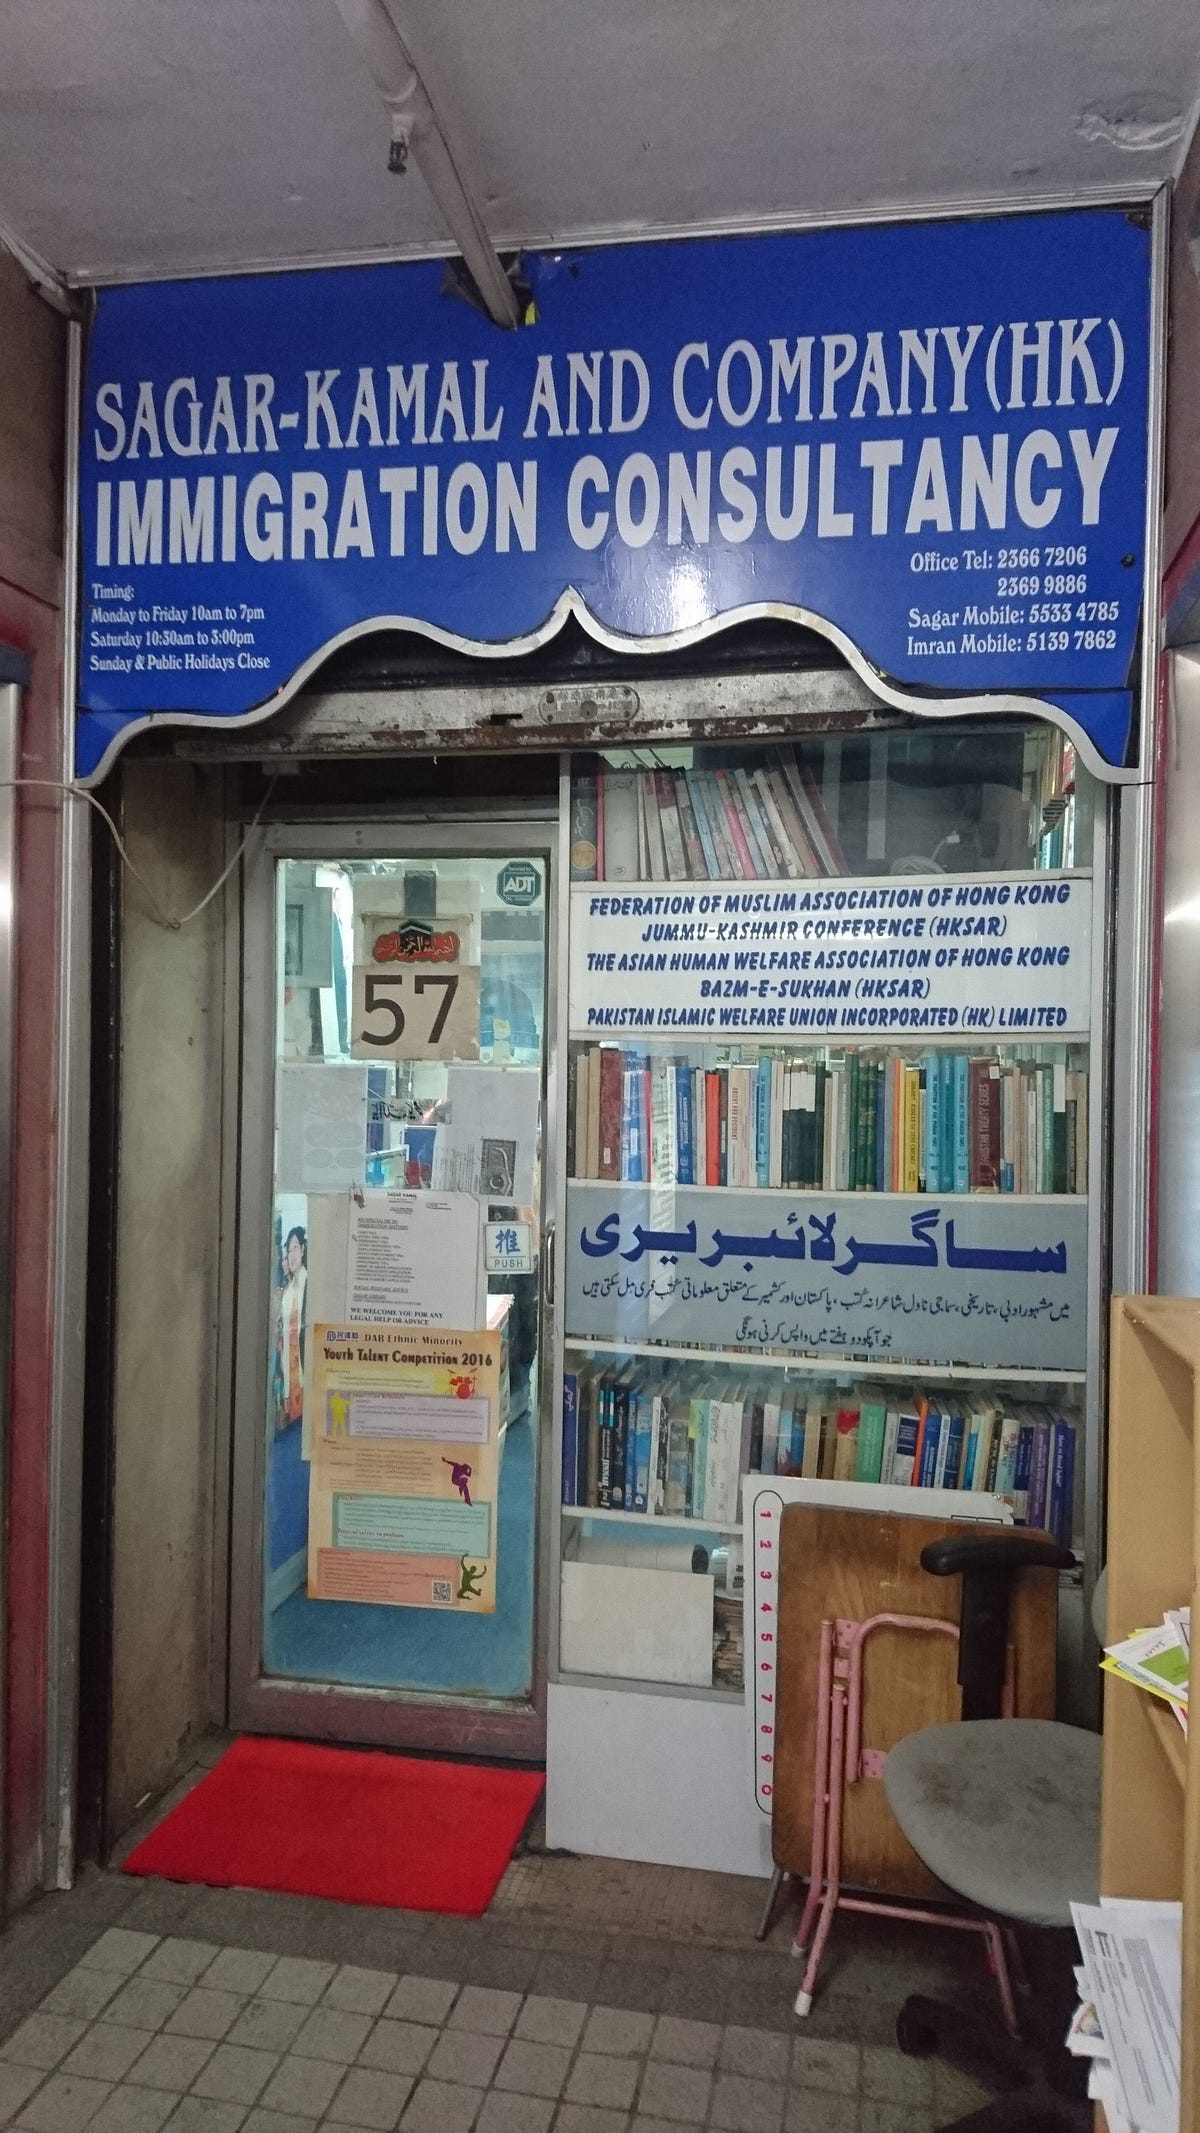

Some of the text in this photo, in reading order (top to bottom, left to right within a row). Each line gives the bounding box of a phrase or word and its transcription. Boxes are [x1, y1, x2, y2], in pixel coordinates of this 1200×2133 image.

[95, 318, 1125, 462] SAGAR-KAMAL AND COMPANY(HK)
[96, 427, 1120, 567] IMMIGRATION CONSULTANCY
[910, 546, 1087, 572] Office Tel: 2366 7206
[91, 583, 135, 601] Timing:
[997, 574, 1087, 597] 2369 9886
[91, 604, 265, 624] Monday to Friday 10am to 7pm
[908, 601, 1119, 631] Sagar Mobile: 5533 4785
[91, 631, 142, 649] Saturday
[197, 631, 209, 645] to
[907, 630, 1117, 655] Imran Mobile: 5139 7862
[90, 653, 270, 673] Sunday & Public Holidays Close
[504, 877, 534, 893] ADT
[589, 883, 1070, 916] FEDERATION OF MUSLIM ASSOCIATION OF HONG KONG
[642, 915, 1007, 942] JUMMU-KASHMIR CONFERENCE (HKSAR)
[587, 946, 1070, 971] THE ASIAN HUMAN WELFARE ASSOCIATION OF HONG KONG
[700, 977, 930, 999] BAZM-E-SUKHAN (HKSAR)
[361, 974, 459, 1046] 57
[587, 1006, 1068, 1028] PAKISTAN ISLAMIC WELFARE UNION INCORPORATED (HK) LIMITED
[495, 1229, 520, 1255] 推
[580, 1208, 1067, 1276] ساگر لائبریری
[494, 1259, 523, 1268] PUSH
[362, 1308, 396, 1316] WELCOME
[364, 1333, 384, 1342] DAB
[387, 1334, 419, 1344] Ethnic
[422, 1336, 463, 1346] Minority
[323, 1347, 493, 1367] Youth Talent Competition 2016
[760, 1540, 772, 1549] 2
[760, 1571, 772, 1580] 3
[760, 1602, 772, 1612] 4
[760, 1633, 772, 1642] 5
[760, 1663, 772, 1671] 6
[761, 1694, 772, 1702] 7
[760, 1725, 772, 1733] 8
[761, 1754, 773, 1763] 9
[761, 1784, 772, 1795] 0
